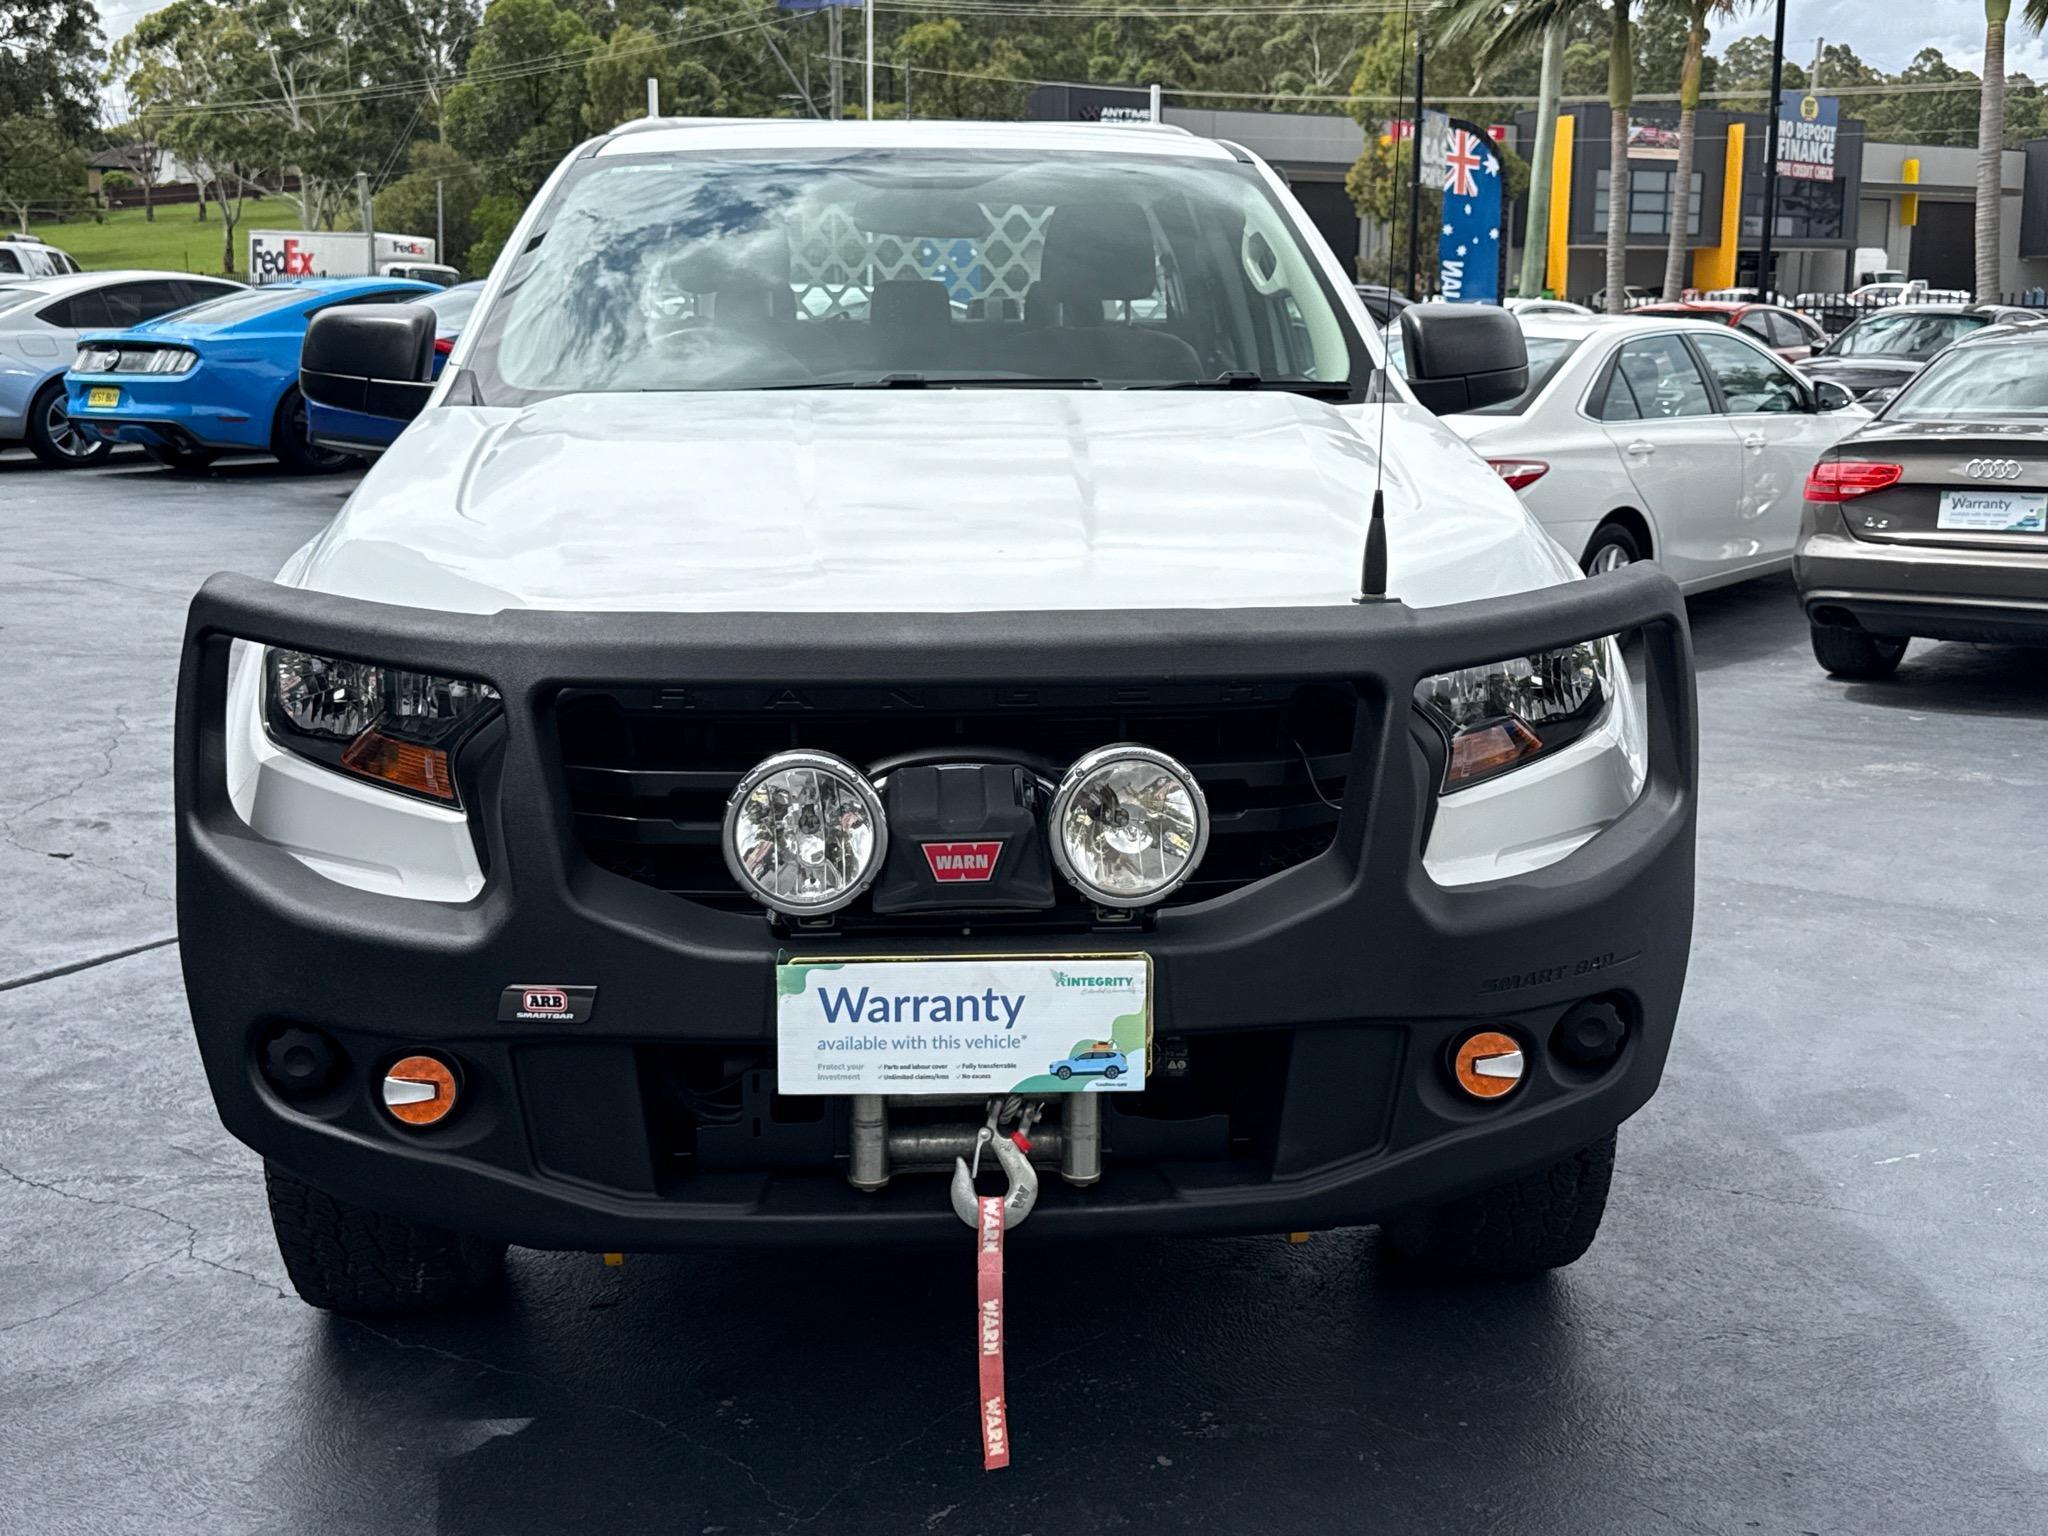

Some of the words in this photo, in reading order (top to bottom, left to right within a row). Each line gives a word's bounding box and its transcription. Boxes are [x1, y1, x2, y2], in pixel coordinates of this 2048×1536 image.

[1778, 120, 1794, 138] NO
[1796, 122, 1837, 143] DEPOSIT
[1777, 138, 1835, 165] FINANCE
[252, 238, 315, 275] FedEx
[392, 241, 425, 255] FedEx
[1951, 497, 2012, 512] Warranty
[935, 854, 989, 870] WARN
[1067, 976, 1133, 987] INTEGRITY
[529, 995, 563, 1008] ARB
[816, 986, 1026, 1030] Warranty
[817, 1035, 888, 1051] available
[891, 1035, 927, 1051] with
[932, 1034, 961, 1050] this
[817, 1063, 846, 1071] Protect
[847, 1064, 864, 1072] your
[962, 1062, 977, 1070] Fully
[982, 1199, 1001, 1253] WARN
[982, 1298, 1000, 1356] WARN
[985, 1395, 1005, 1457] WARN
